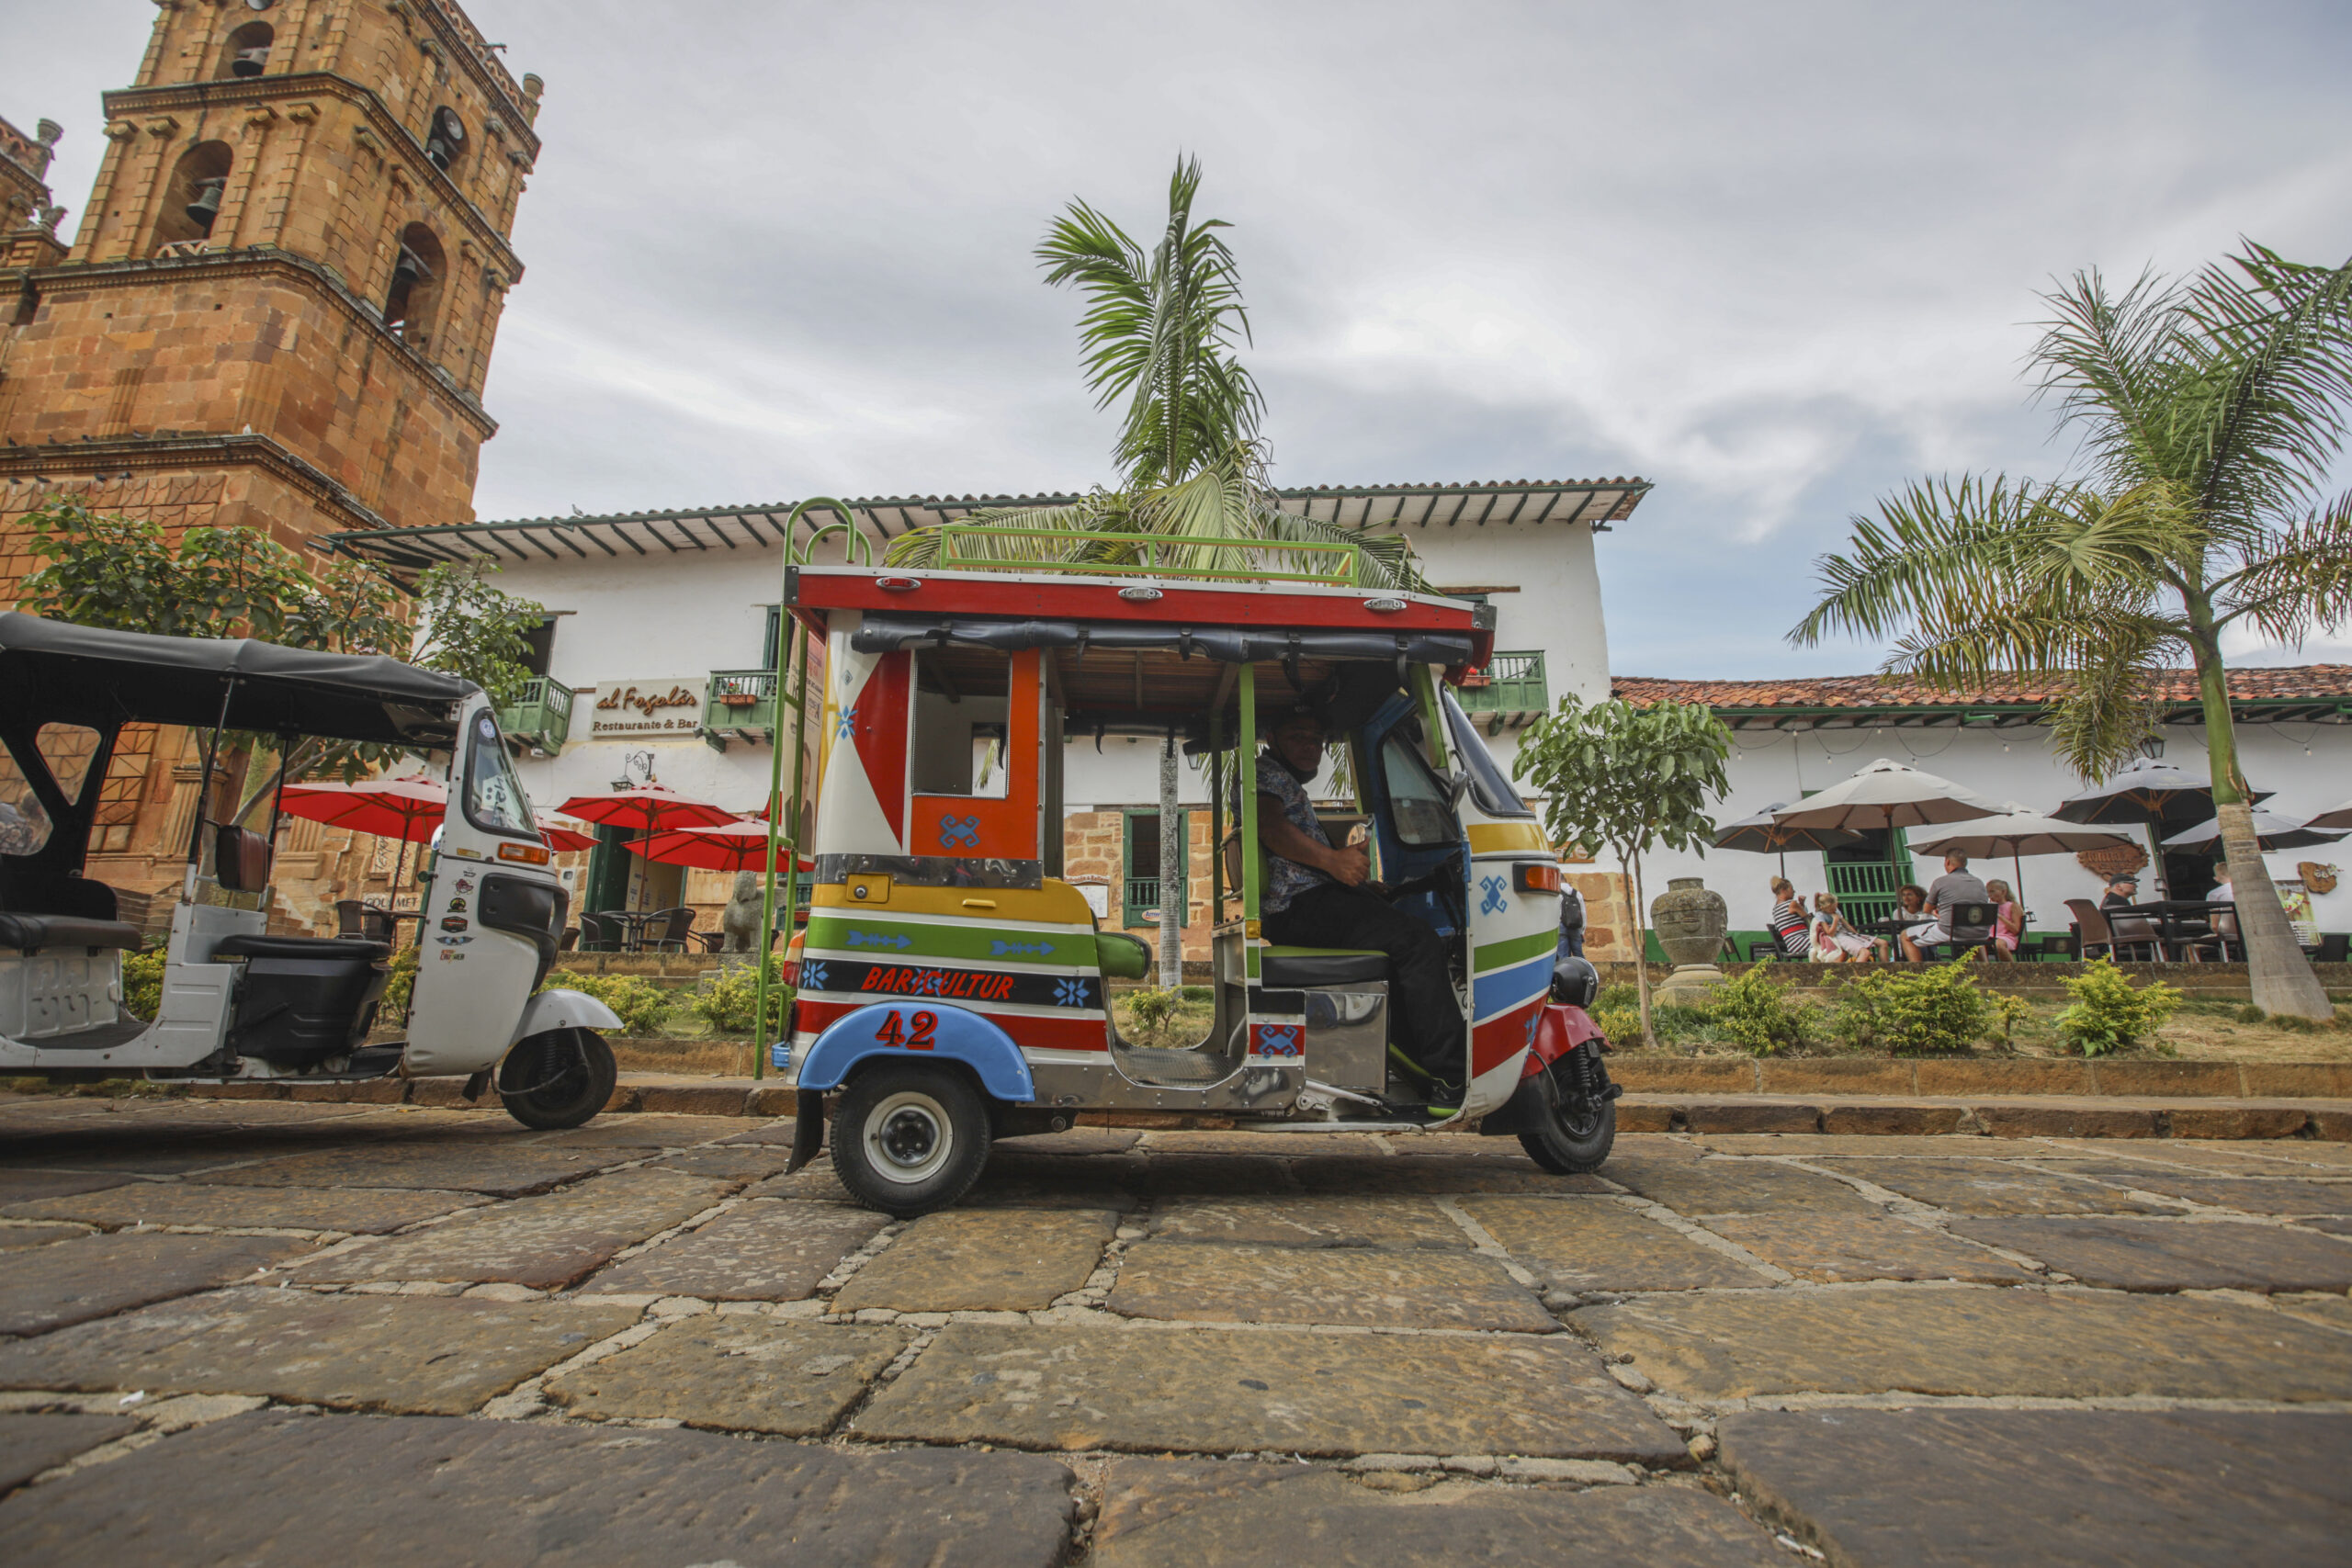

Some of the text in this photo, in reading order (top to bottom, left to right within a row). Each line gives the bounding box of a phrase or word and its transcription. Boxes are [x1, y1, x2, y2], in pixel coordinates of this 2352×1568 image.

[596, 687, 621, 709] al
[592, 718, 698, 732] Restaurante & Bar
[366, 897, 418, 908] GOUMET
[861, 966, 1014, 1000] BARICULTUR
[875, 1010, 939, 1051] 42
